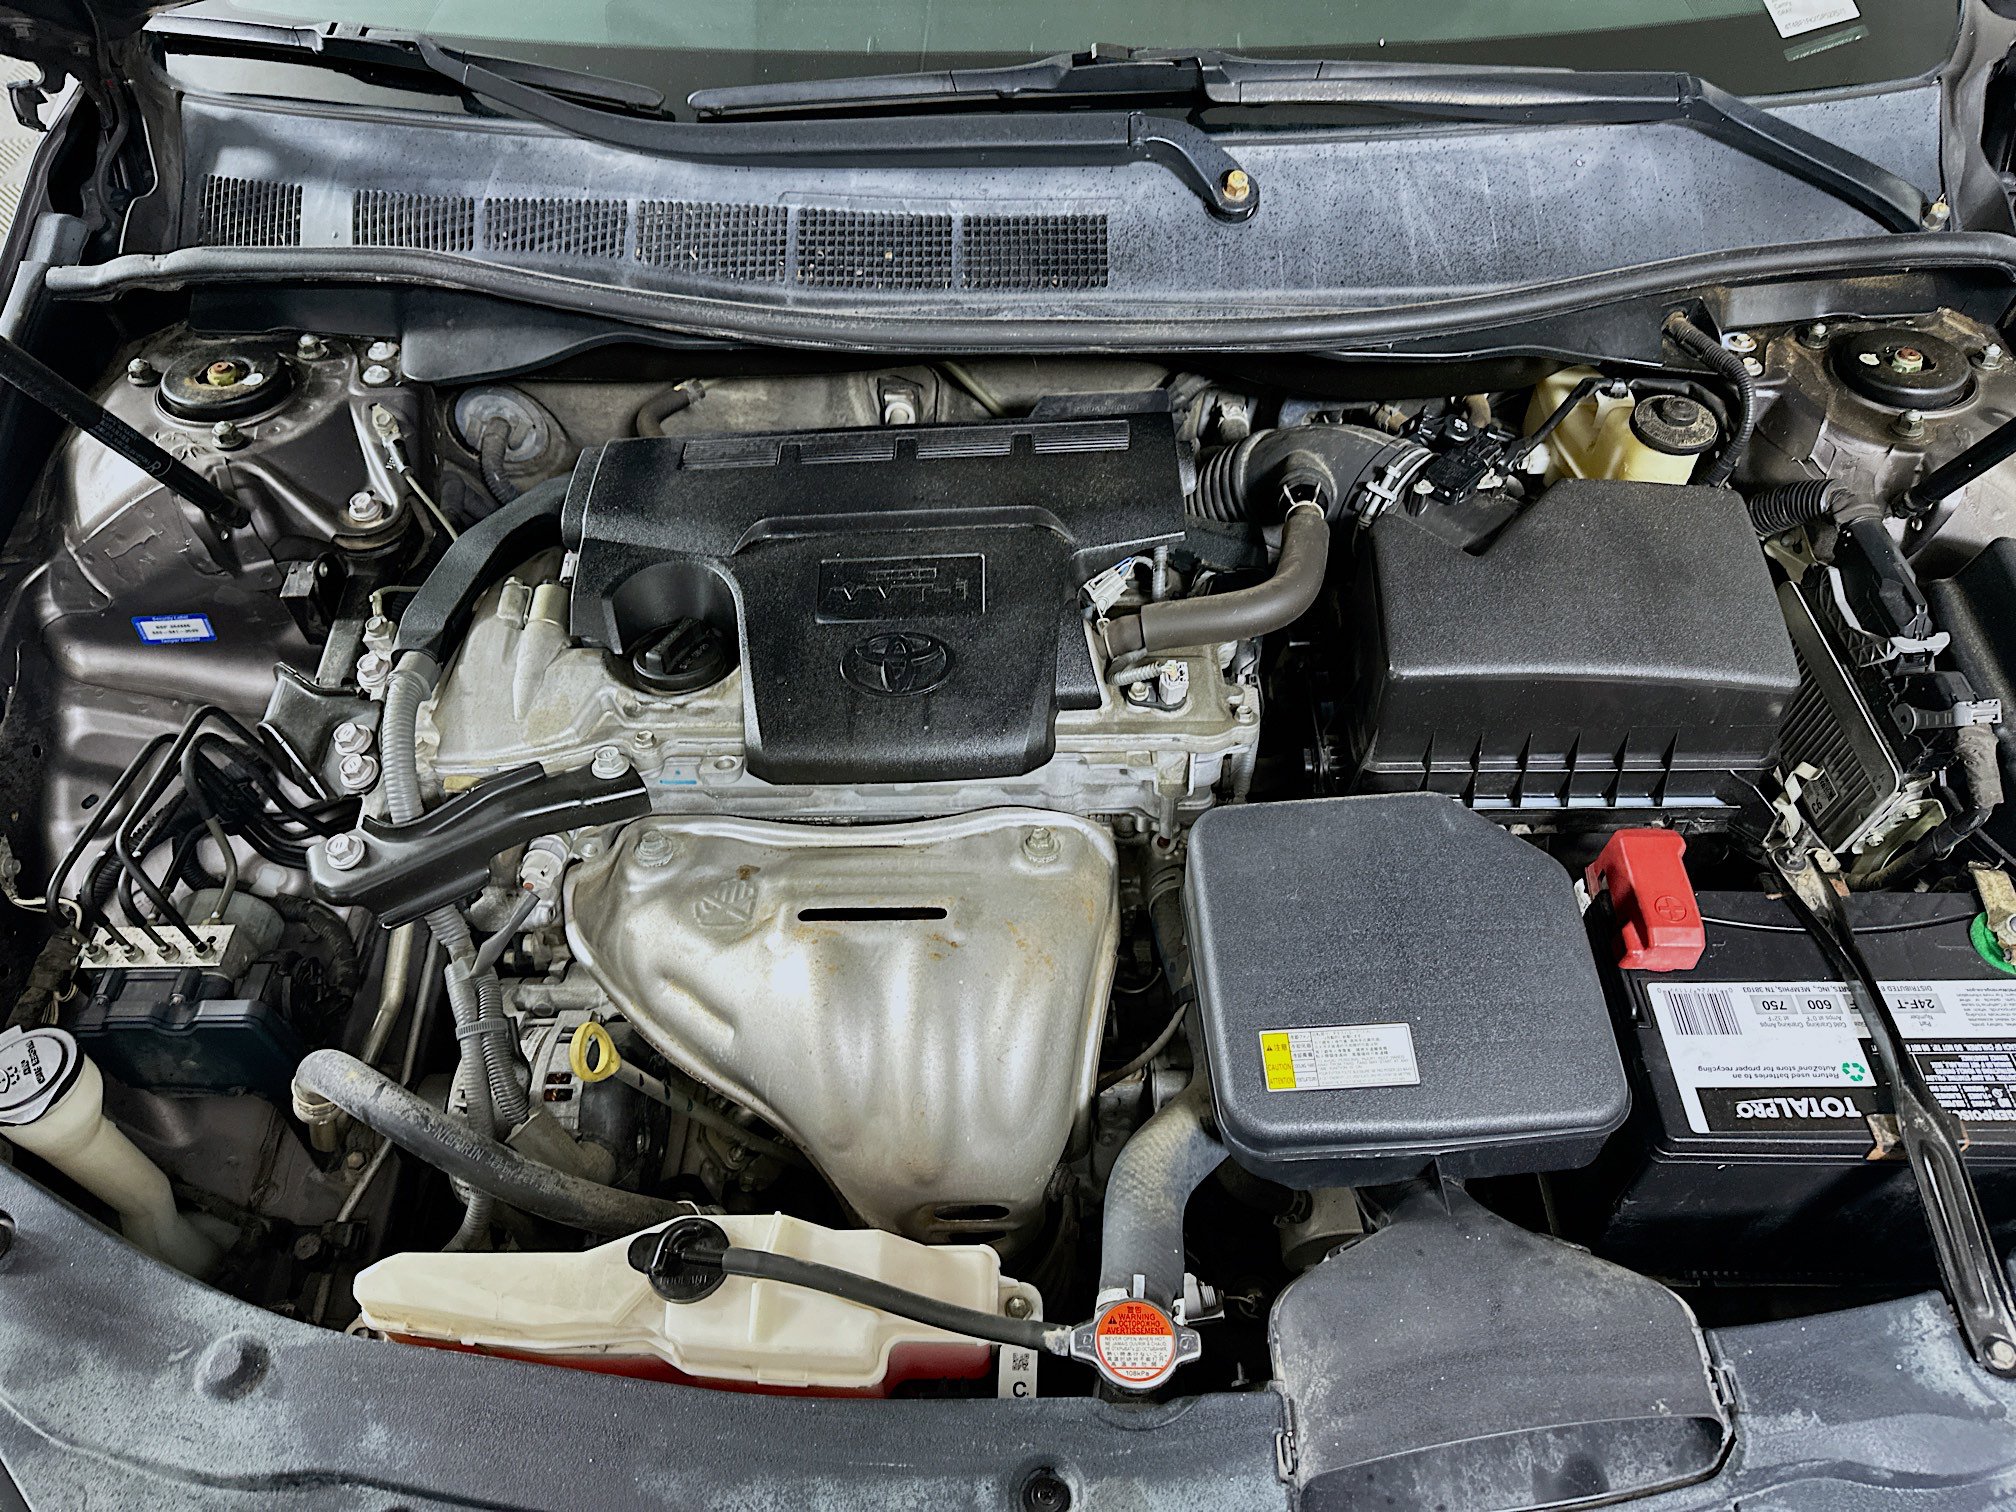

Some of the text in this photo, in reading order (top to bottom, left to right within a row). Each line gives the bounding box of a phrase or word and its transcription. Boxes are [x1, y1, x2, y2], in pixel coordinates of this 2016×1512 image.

[1762, 1000, 1787, 1010] 750
[1807, 999, 1832, 1009] 600
[1896, 999, 1934, 1009] 24F-T
[1267, 1062, 1292, 1071] CAUTION
[1735, 1064, 1761, 1072] proper
[1269, 1077, 1294, 1085] ATTENTION
[1735, 1096, 1862, 1118] TOTALPRO
